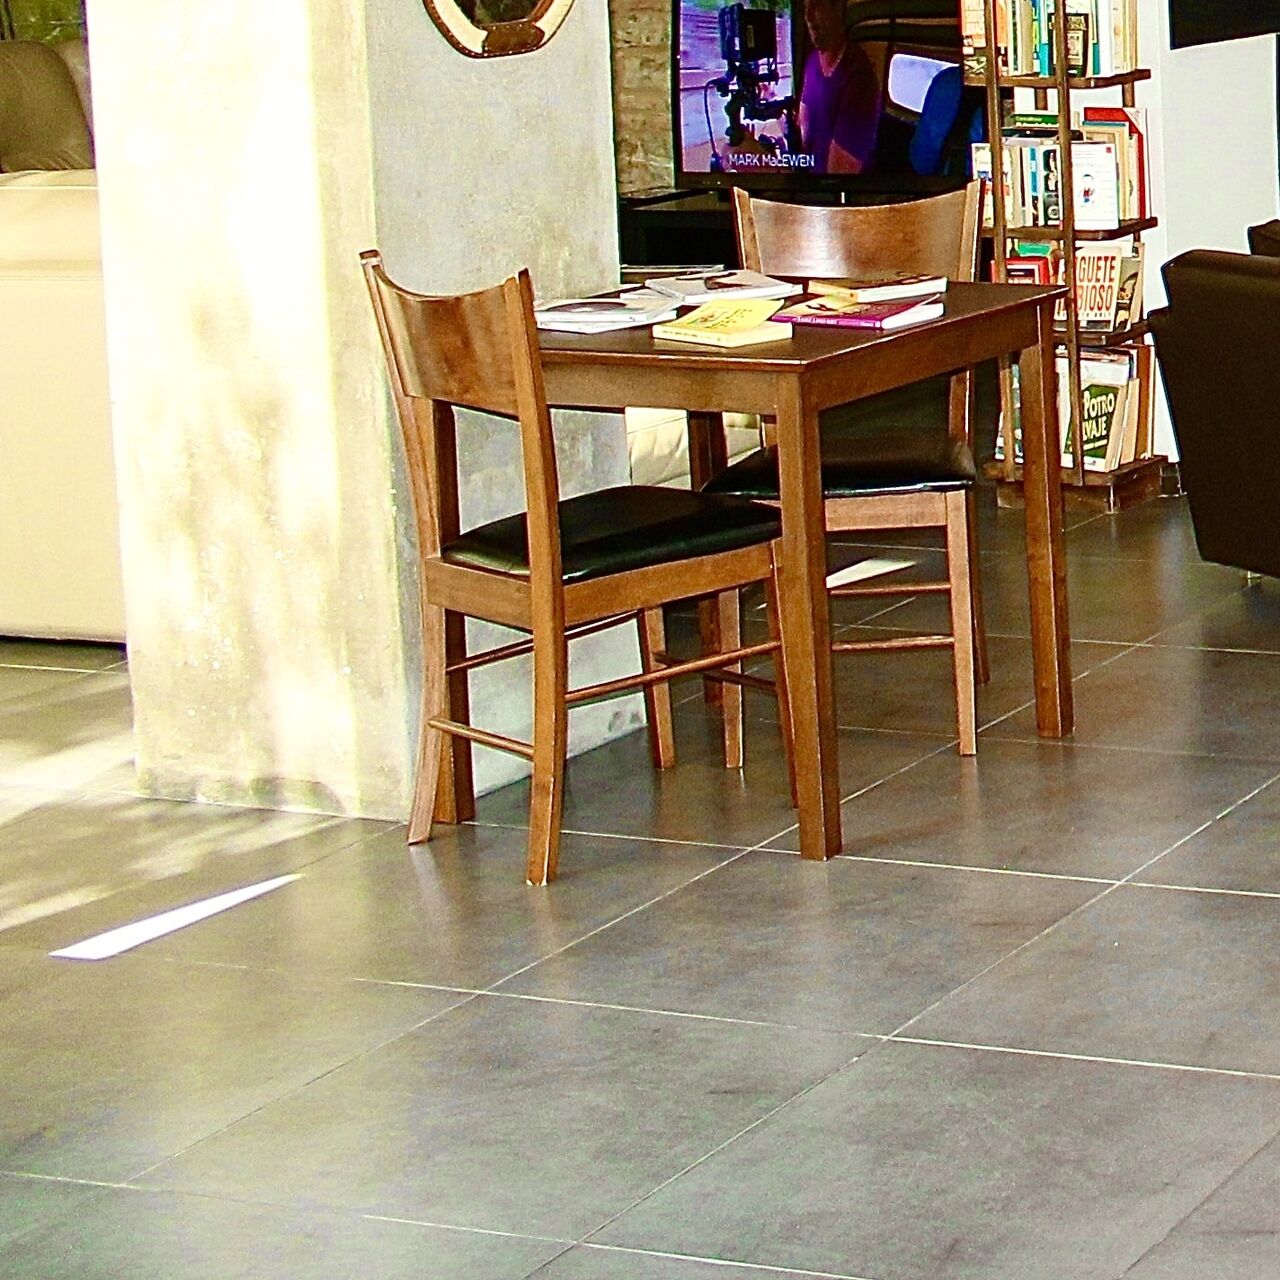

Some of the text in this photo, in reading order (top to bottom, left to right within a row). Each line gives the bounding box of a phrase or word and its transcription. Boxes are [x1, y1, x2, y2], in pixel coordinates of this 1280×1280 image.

[728, 153, 815, 167] MARK MacEWEN
[1076, 255, 1116, 283] GUETE
[1077, 283, 1114, 311] BIOSO
[1083, 390, 1115, 420] POTRO
[1083, 416, 1107, 441] LVAJE
